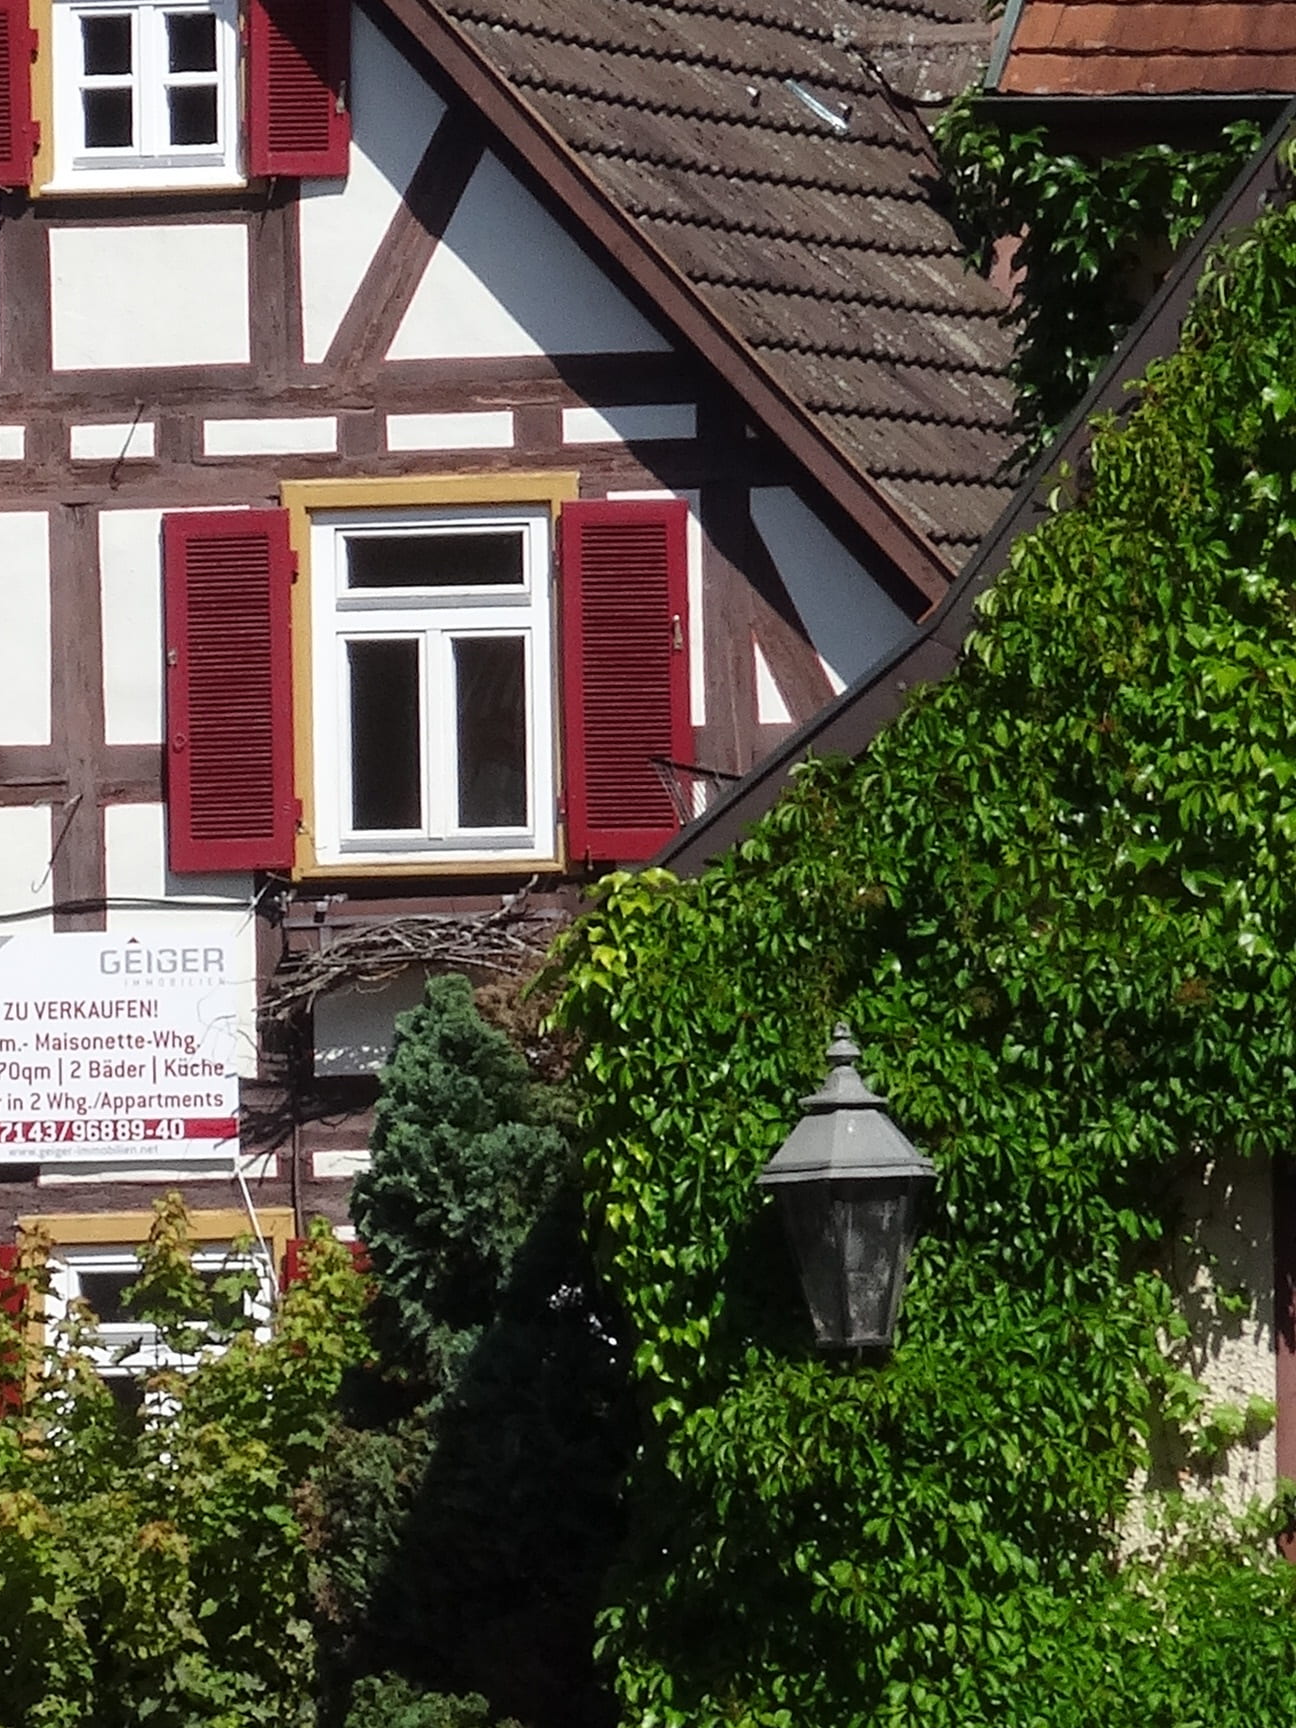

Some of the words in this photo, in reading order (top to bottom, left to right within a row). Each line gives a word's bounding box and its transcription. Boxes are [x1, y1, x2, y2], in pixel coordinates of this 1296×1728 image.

[100, 947, 225, 974] GEIGER
[124, 976, 227, 988] IMMOBILIEN
[3, 1002, 28, 1021] ZU
[34, 1000, 159, 1020] VERKAUFEN!
[35, 1030, 201, 1054] Maisonette-Whg.
[70, 1061, 81, 1079] 2
[89, 1059, 146, 1079] Bäder
[164, 1057, 225, 1078] Küche
[8, 1093, 24, 1111] in
[29, 1093, 42, 1111] 2
[47, 1090, 225, 1115] Whg./Appartments
[8, 1144, 159, 1159] www.geiger-immobilien.net
